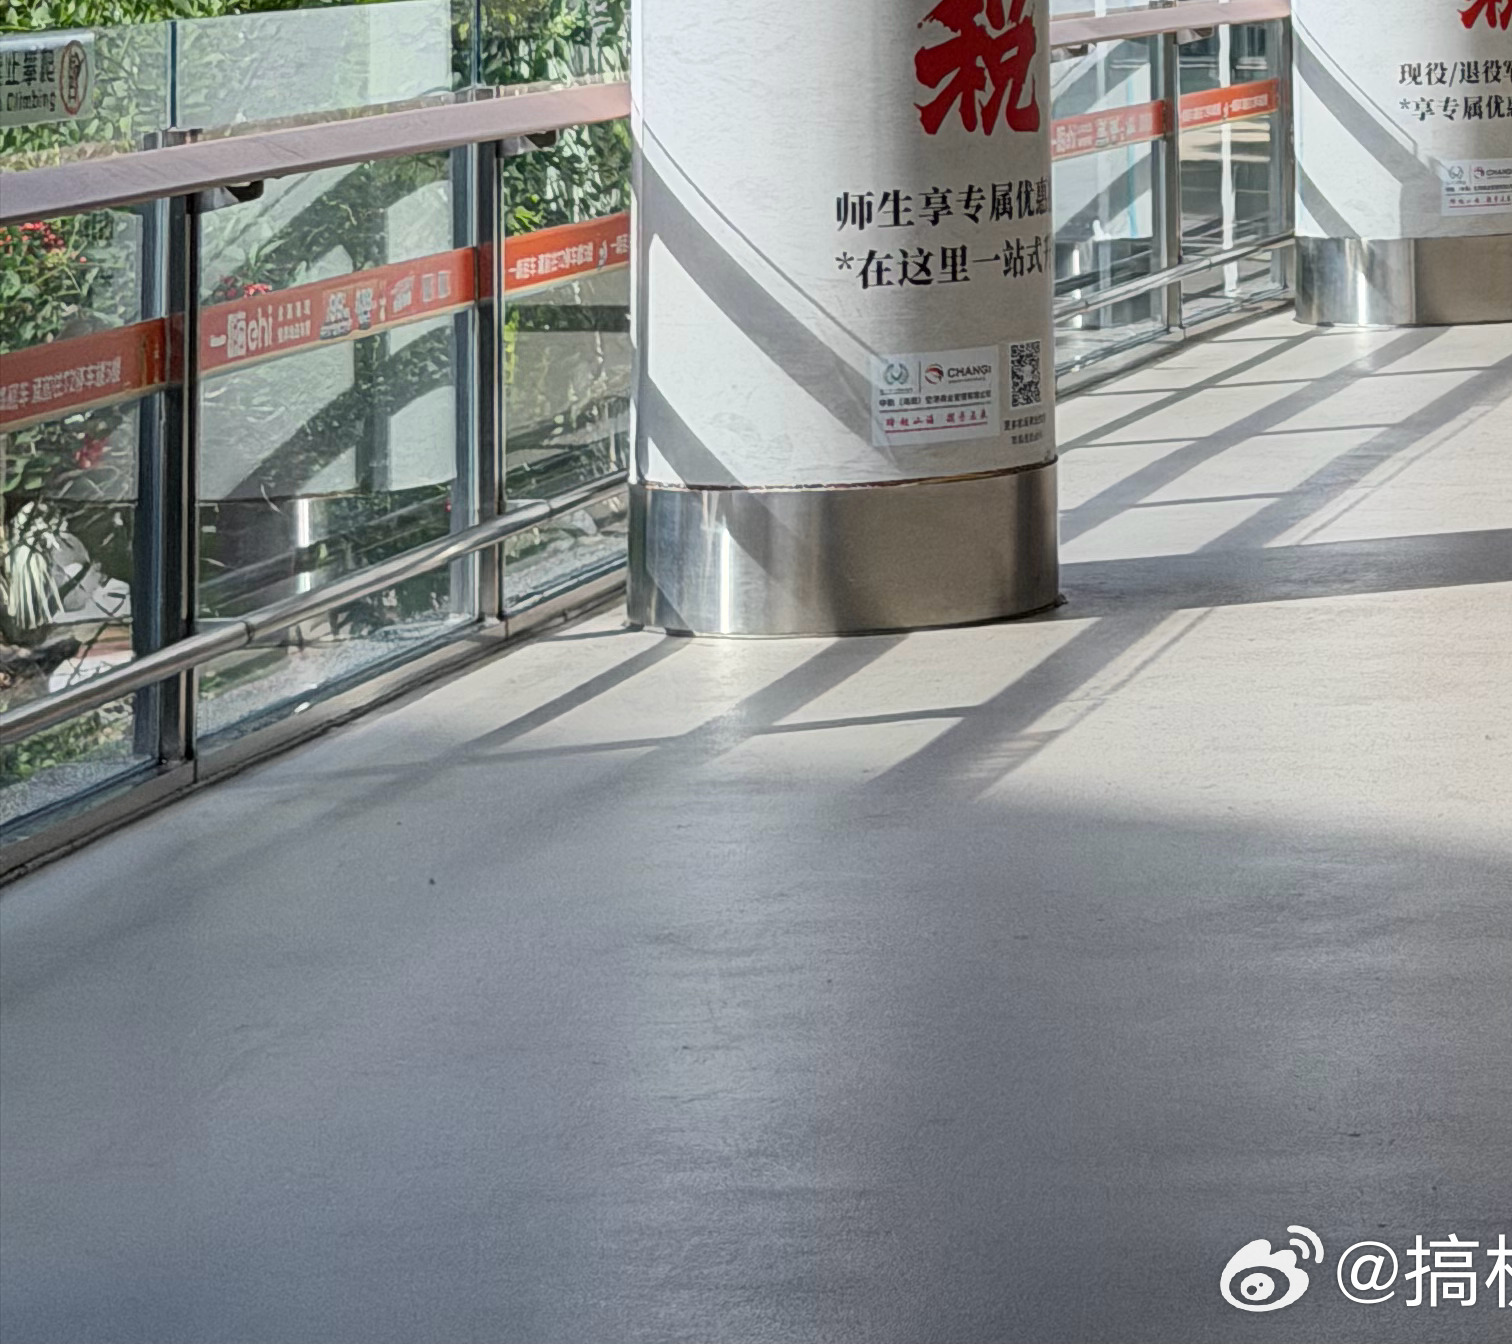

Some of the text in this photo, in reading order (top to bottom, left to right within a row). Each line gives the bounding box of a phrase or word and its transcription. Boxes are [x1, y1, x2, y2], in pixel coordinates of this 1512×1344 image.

[0, 48, 55, 86] 止攀爬
[947, 365, 992, 378] CHANGI
